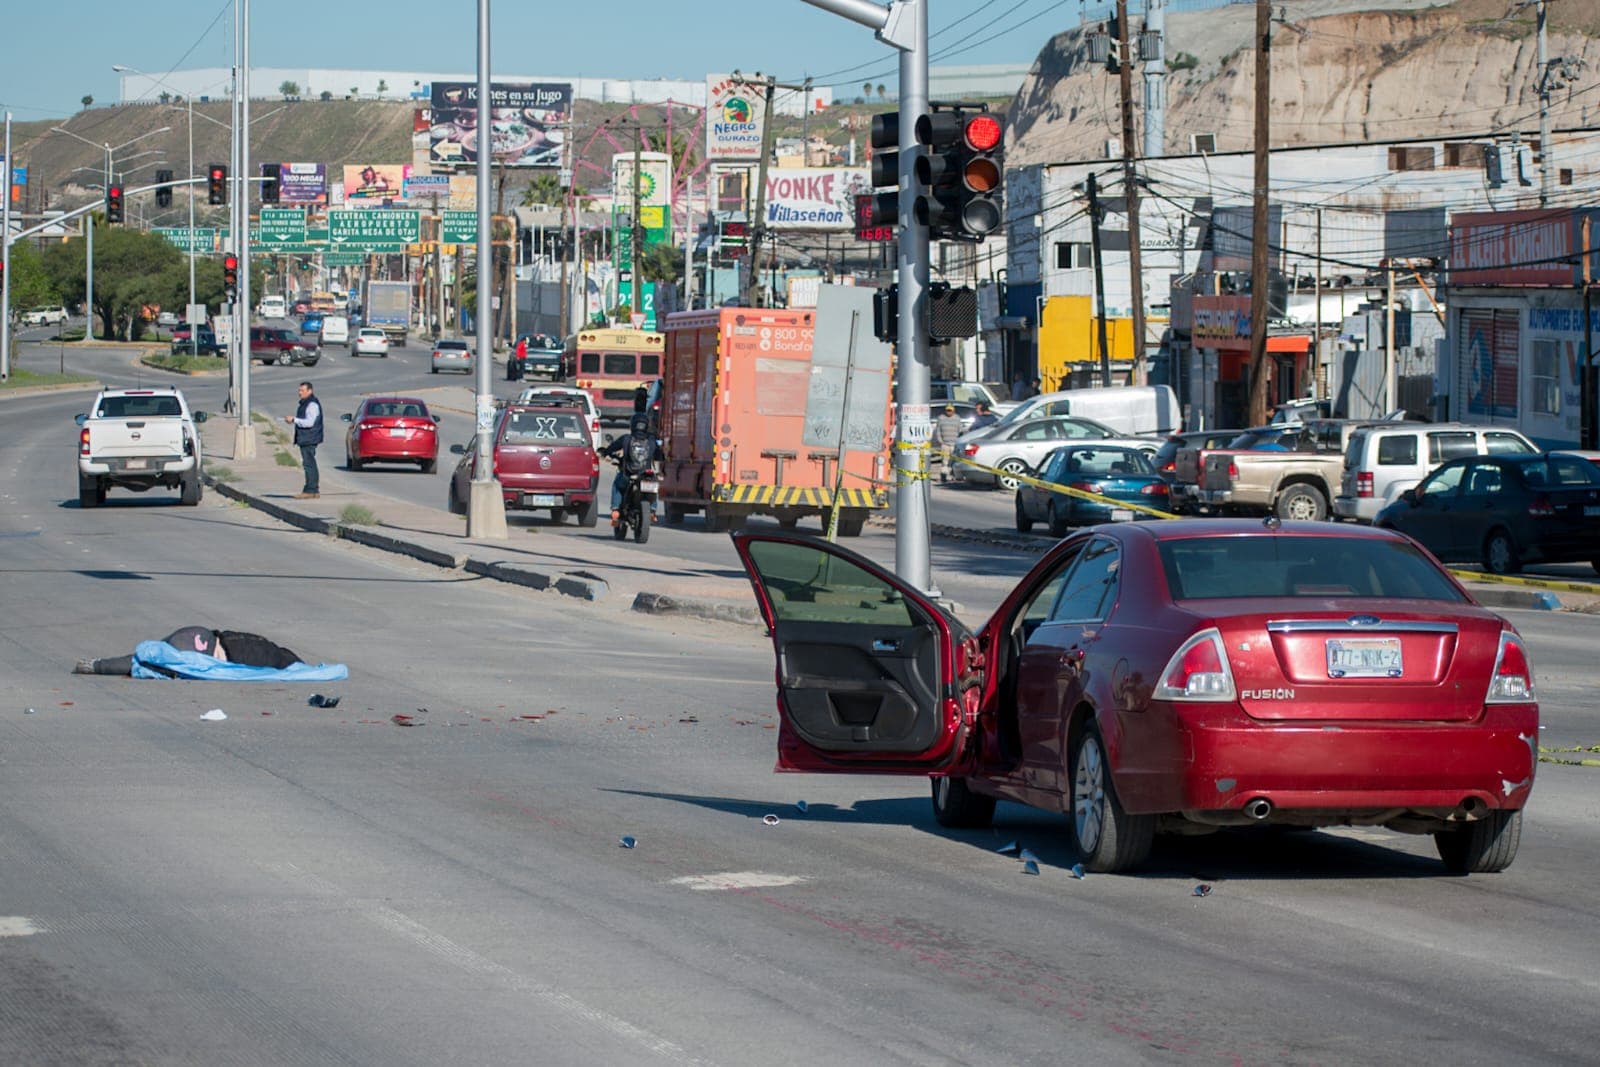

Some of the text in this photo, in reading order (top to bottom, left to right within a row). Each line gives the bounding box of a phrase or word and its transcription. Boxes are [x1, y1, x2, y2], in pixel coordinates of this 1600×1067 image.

[509, 92, 521, 100] en
[523, 92, 535, 100] su
[536, 88, 562, 104] Jugo
[714, 123, 756, 135] NEGRO
[766, 173, 834, 205] YONKE
[333, 212, 416, 220] CENTRAL CAMIONERA
[339, 220, 410, 228] AEROPUERTO
[332, 228, 417, 236] GARITA MESA DE OTAY
[1452, 227, 1466, 269] EL
[1508, 222, 1570, 270] ORIGINAL
[644, 293, 653, 310] 2
[774, 328, 797, 340] 800
[535, 417, 557, 439] X
[1241, 688, 1295, 700] FUSION
